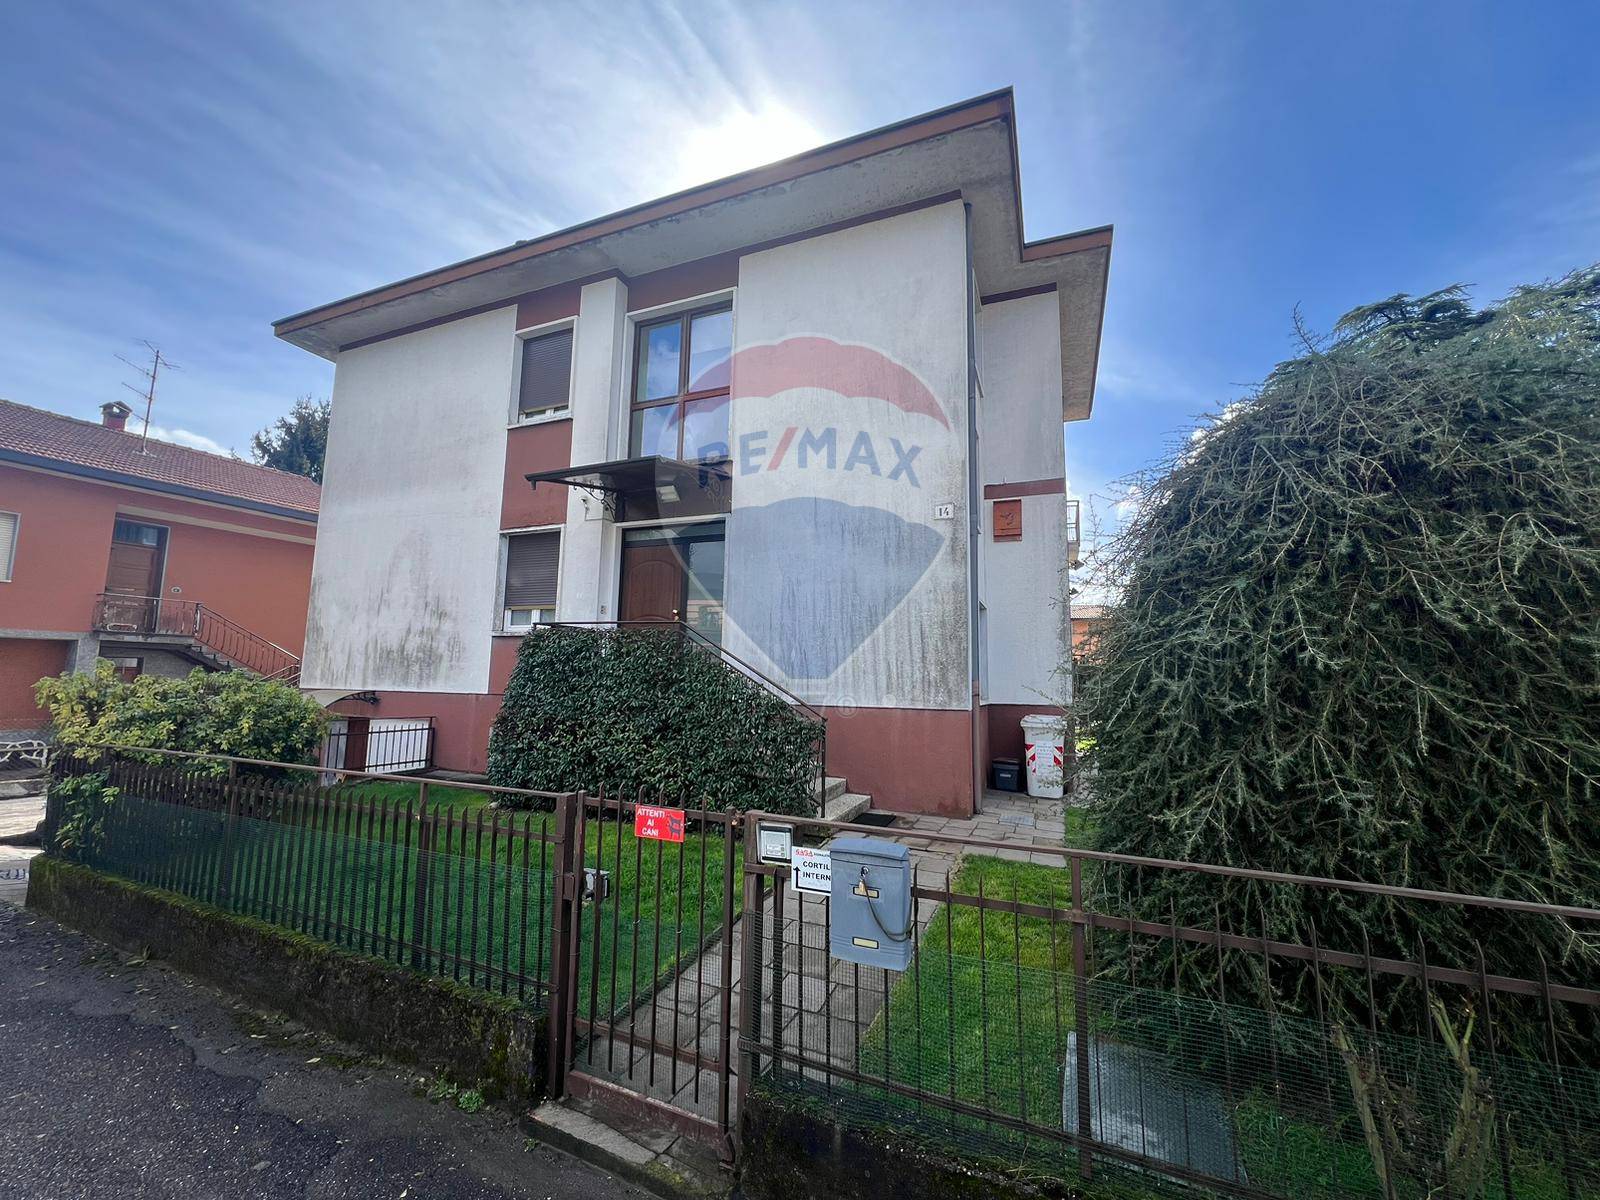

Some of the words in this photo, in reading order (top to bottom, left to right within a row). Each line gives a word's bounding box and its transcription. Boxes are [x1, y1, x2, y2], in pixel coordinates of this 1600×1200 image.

[939, 507, 949, 517] 14
[637, 808, 665, 818] ATTENTI
[647, 819, 655, 827] AI
[641, 827, 659, 837] CANI
